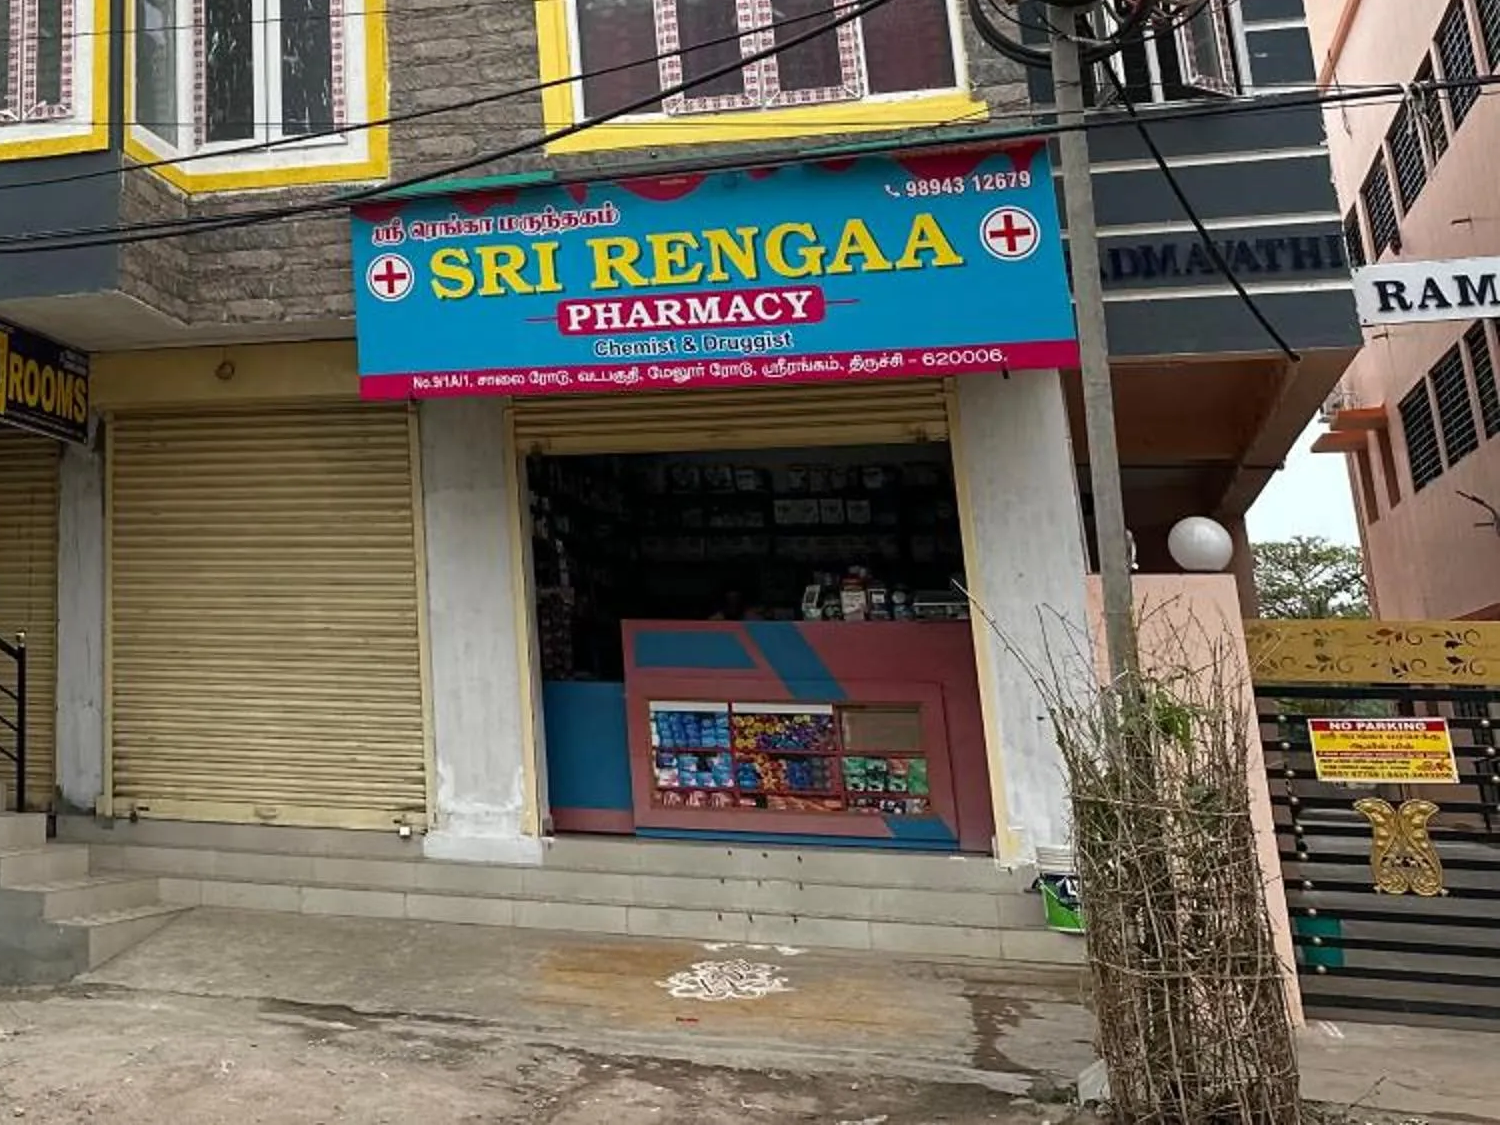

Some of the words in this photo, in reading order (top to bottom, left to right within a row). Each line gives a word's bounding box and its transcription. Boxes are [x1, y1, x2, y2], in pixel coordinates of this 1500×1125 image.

[905, 176, 965, 198] 98943
[972, 170, 1032, 192] 12679
[498, 201, 621, 235] மருந்தகம்
[429, 241, 565, 299] SRI
[586, 213, 965, 290] RENGAA
[1100, 234, 1344, 280] DMAVATHI
[565, 290, 813, 330] PHARMACY
[594, 336, 677, 357] Chemist
[682, 335, 698, 353] &
[703, 330, 794, 355] Druggist
[647, 362, 705, 384] மேலூர்
[848, 352, 904, 374] திருச்சி
[8, 352, 87, 423] ROOMS
[1329, 722, 1353, 731] NO
[1355, 721, 1427, 731] PARKING
